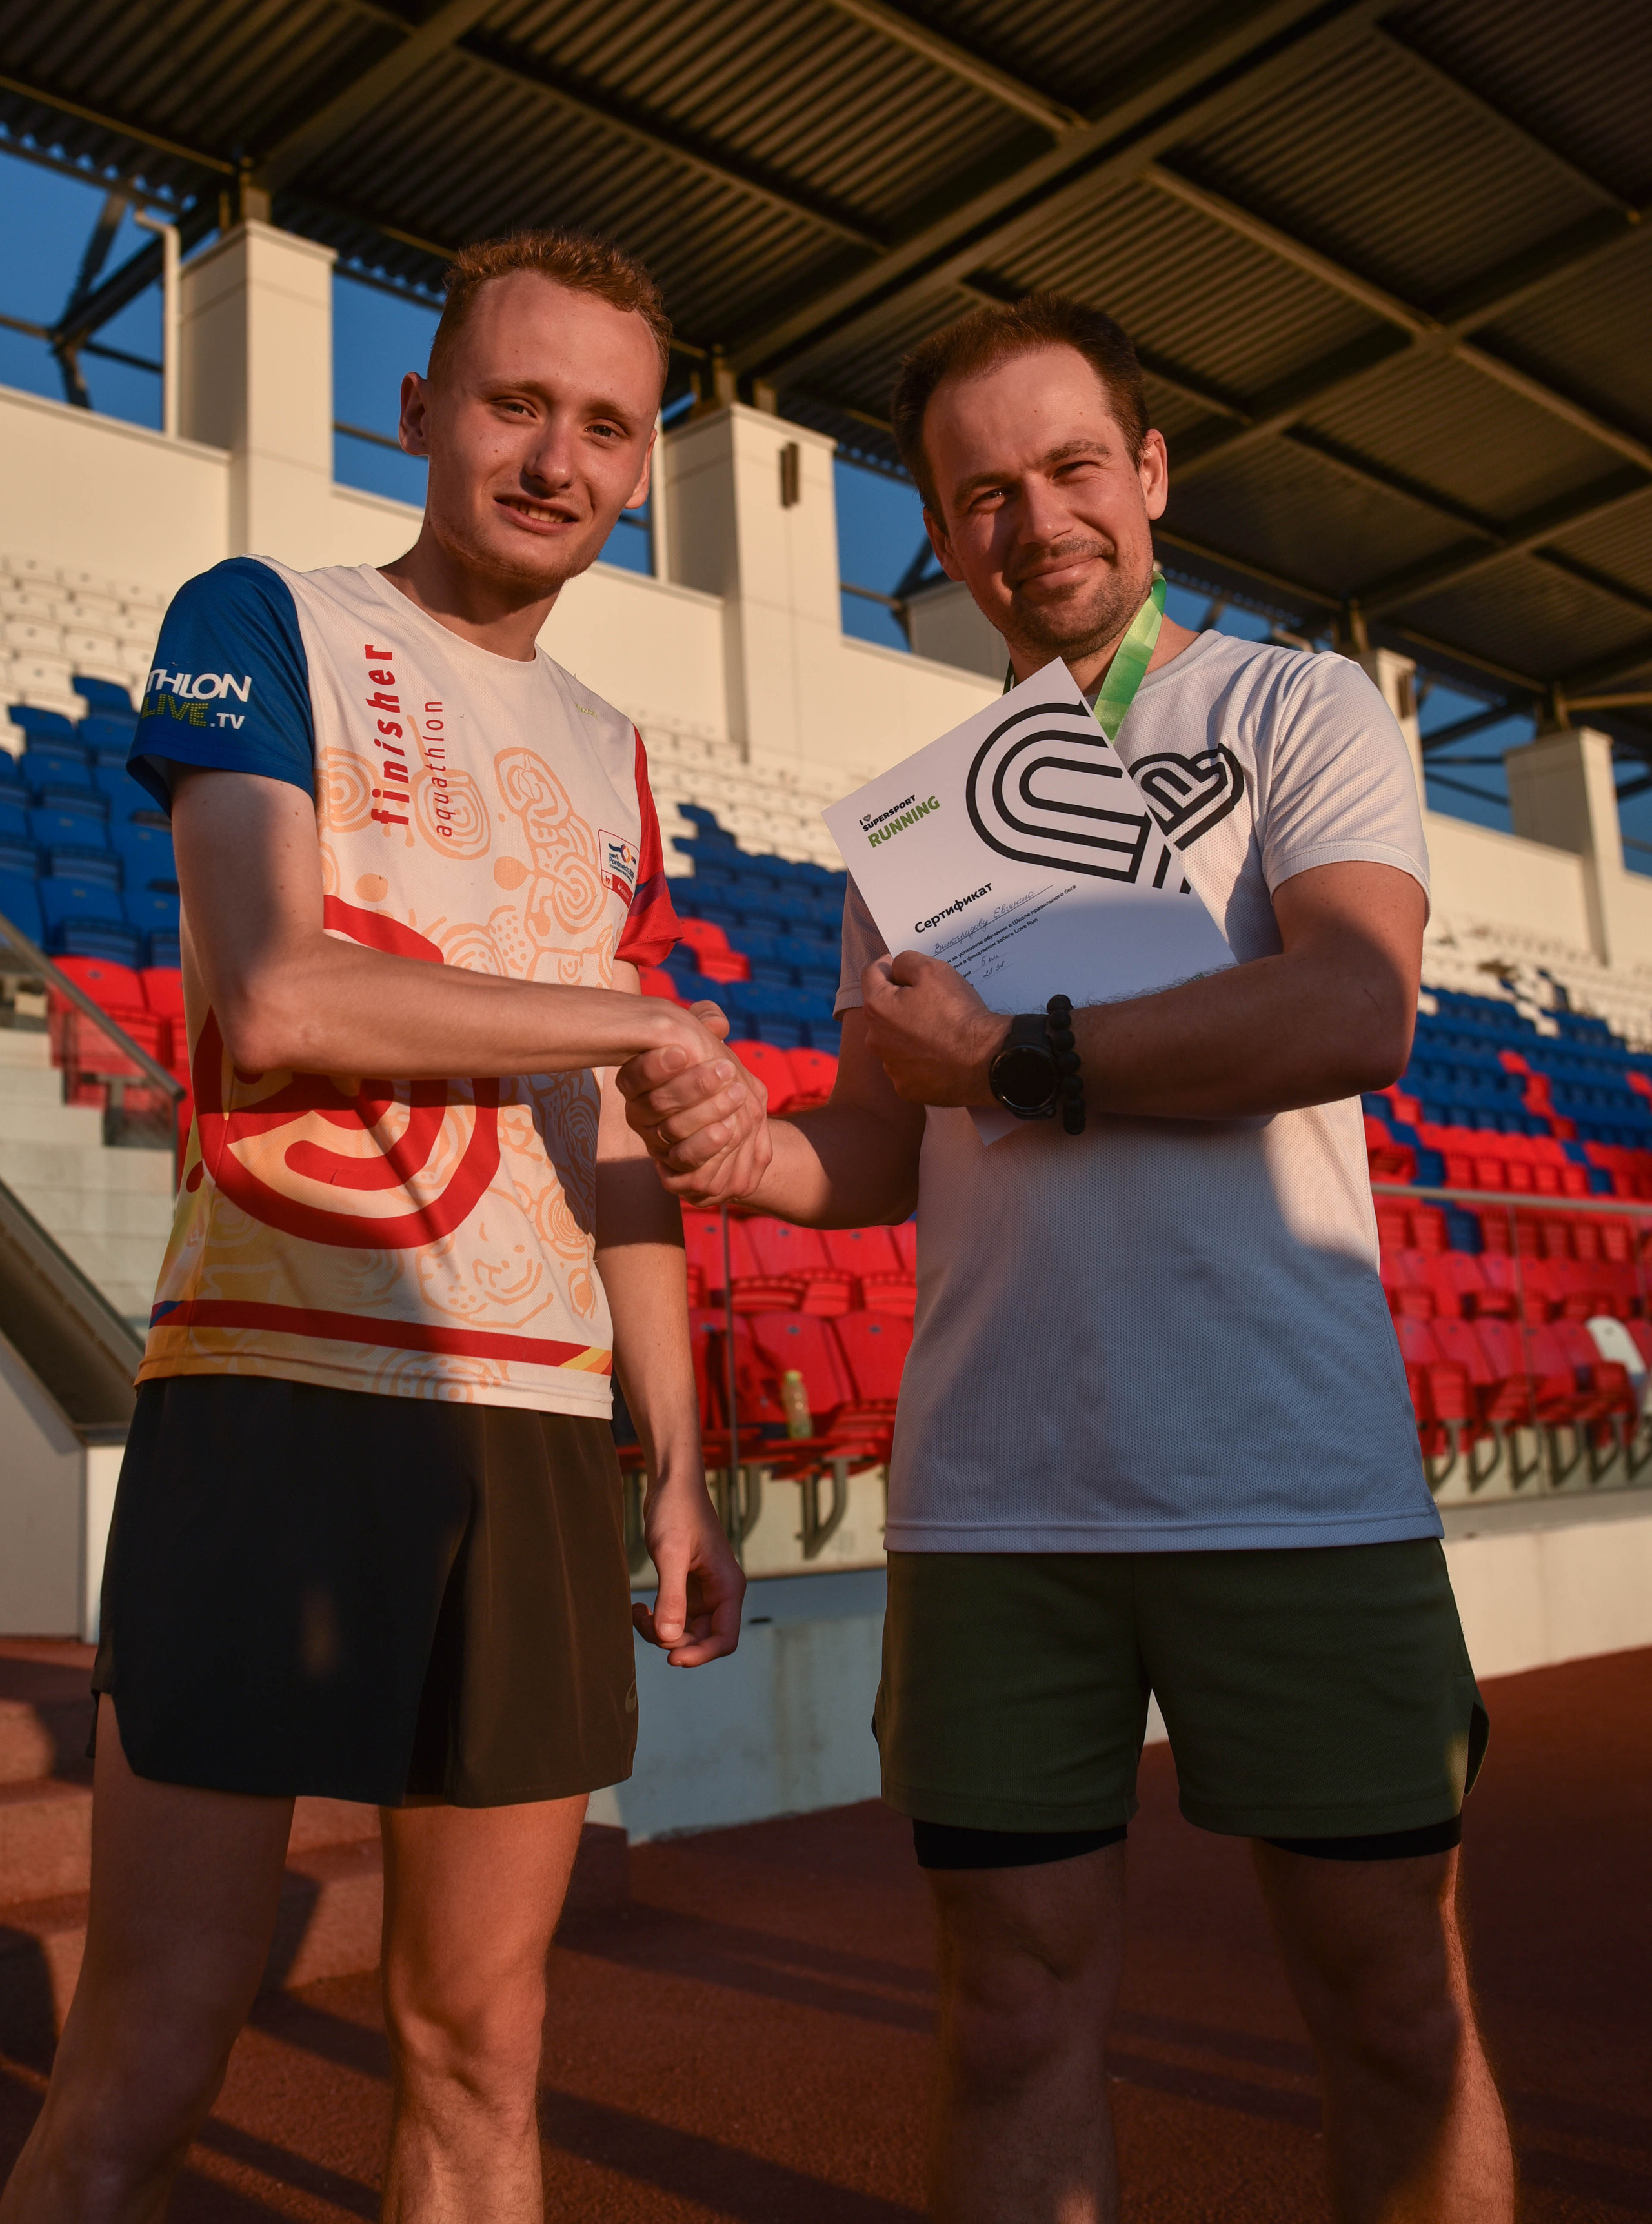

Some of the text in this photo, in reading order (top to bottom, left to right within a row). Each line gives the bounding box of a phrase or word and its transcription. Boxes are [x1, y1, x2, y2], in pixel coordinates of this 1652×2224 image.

[364, 643, 410, 825] finisher
[425, 701, 453, 837] aquathlon
[862, 794, 916, 832] SUPERSPORT
[867, 795, 940, 848] RUNNING
[914, 882, 992, 933] Сертификат
[958, 940, 983, 958] успешное
[983, 925, 1009, 942] обучение
[1012, 913, 1031, 925] Школе
[1031, 893, 1064, 915] правильного
[1064, 885, 1077, 895] бега
[993, 891, 1034, 918] Евгению
[967, 942, 996, 962] финальном
[996, 931, 1014, 944] забеге
[1014, 924, 1027, 934] Love
[1027, 918, 1038, 926] Run
[981, 955, 987, 967] 5
